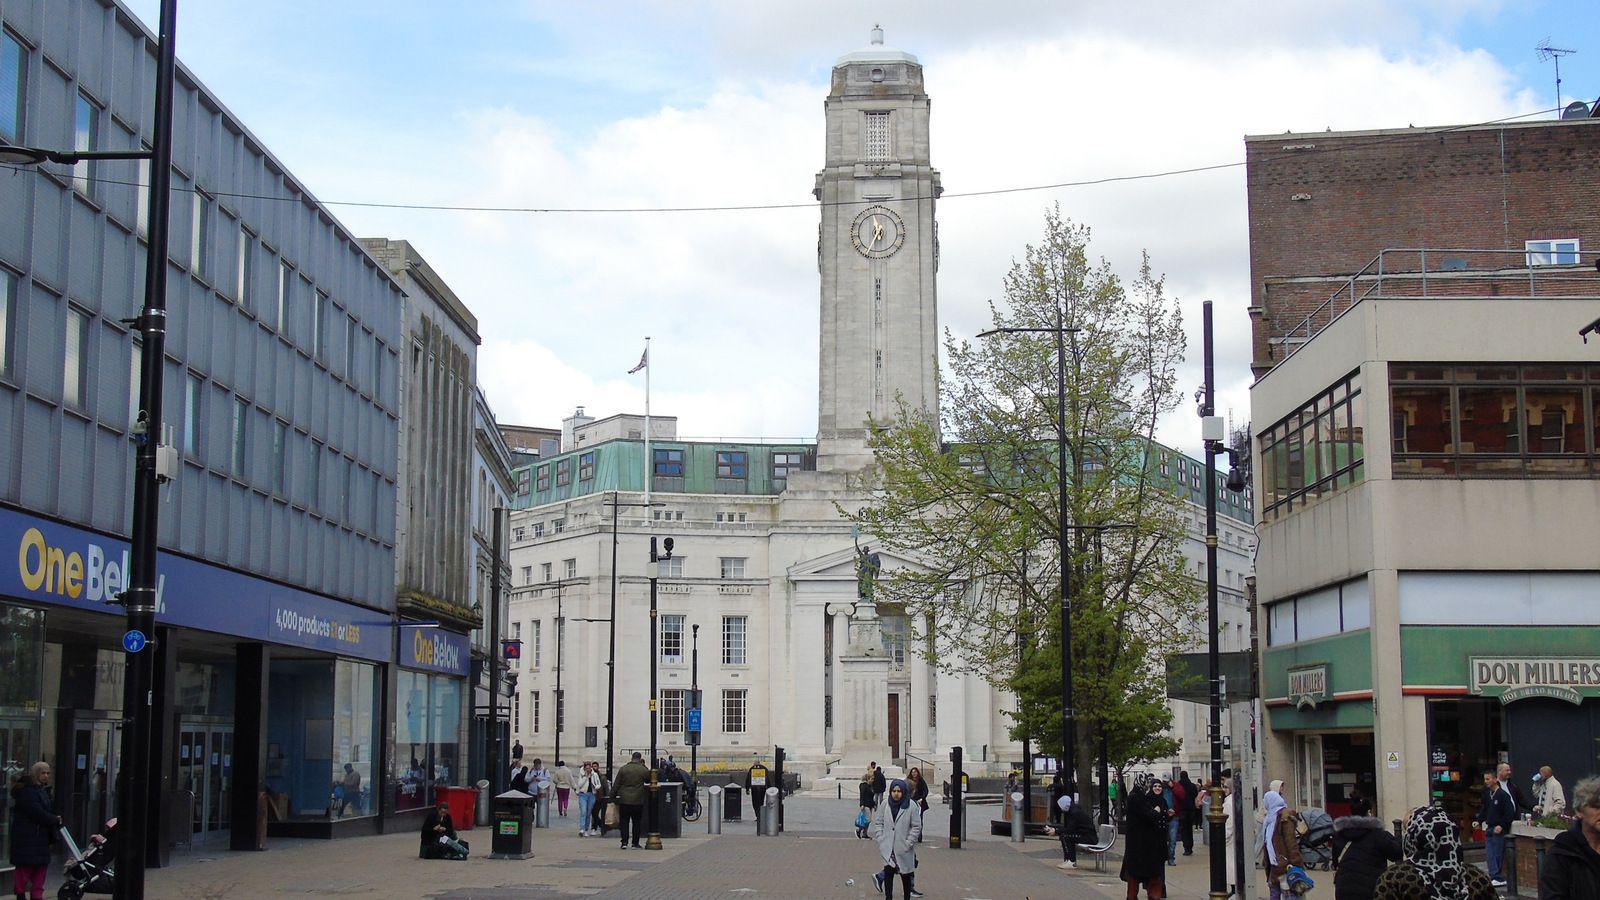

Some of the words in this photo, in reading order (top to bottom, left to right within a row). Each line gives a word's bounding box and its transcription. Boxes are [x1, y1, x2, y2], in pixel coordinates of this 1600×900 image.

[19, 527, 84, 599] One
[87, 543, 165, 614] Bel.
[275, 608, 298, 632] 4,000
[298, 615, 330, 637] products
[338, 625, 345, 640] or
[345, 624, 360, 643] LESS
[414, 630, 433, 664] One
[434, 634, 459, 669] Below.
[1291, 674, 1302, 694] DON
[1302, 671, 1323, 693] MILLERS
[1477, 662, 1520, 684] DON
[1525, 662, 1600, 684] MILLERS
[1502, 691, 1518, 702] HOT
[1520, 687, 1546, 696] BREAD
[1547, 688, 1579, 703] KITCHEN
